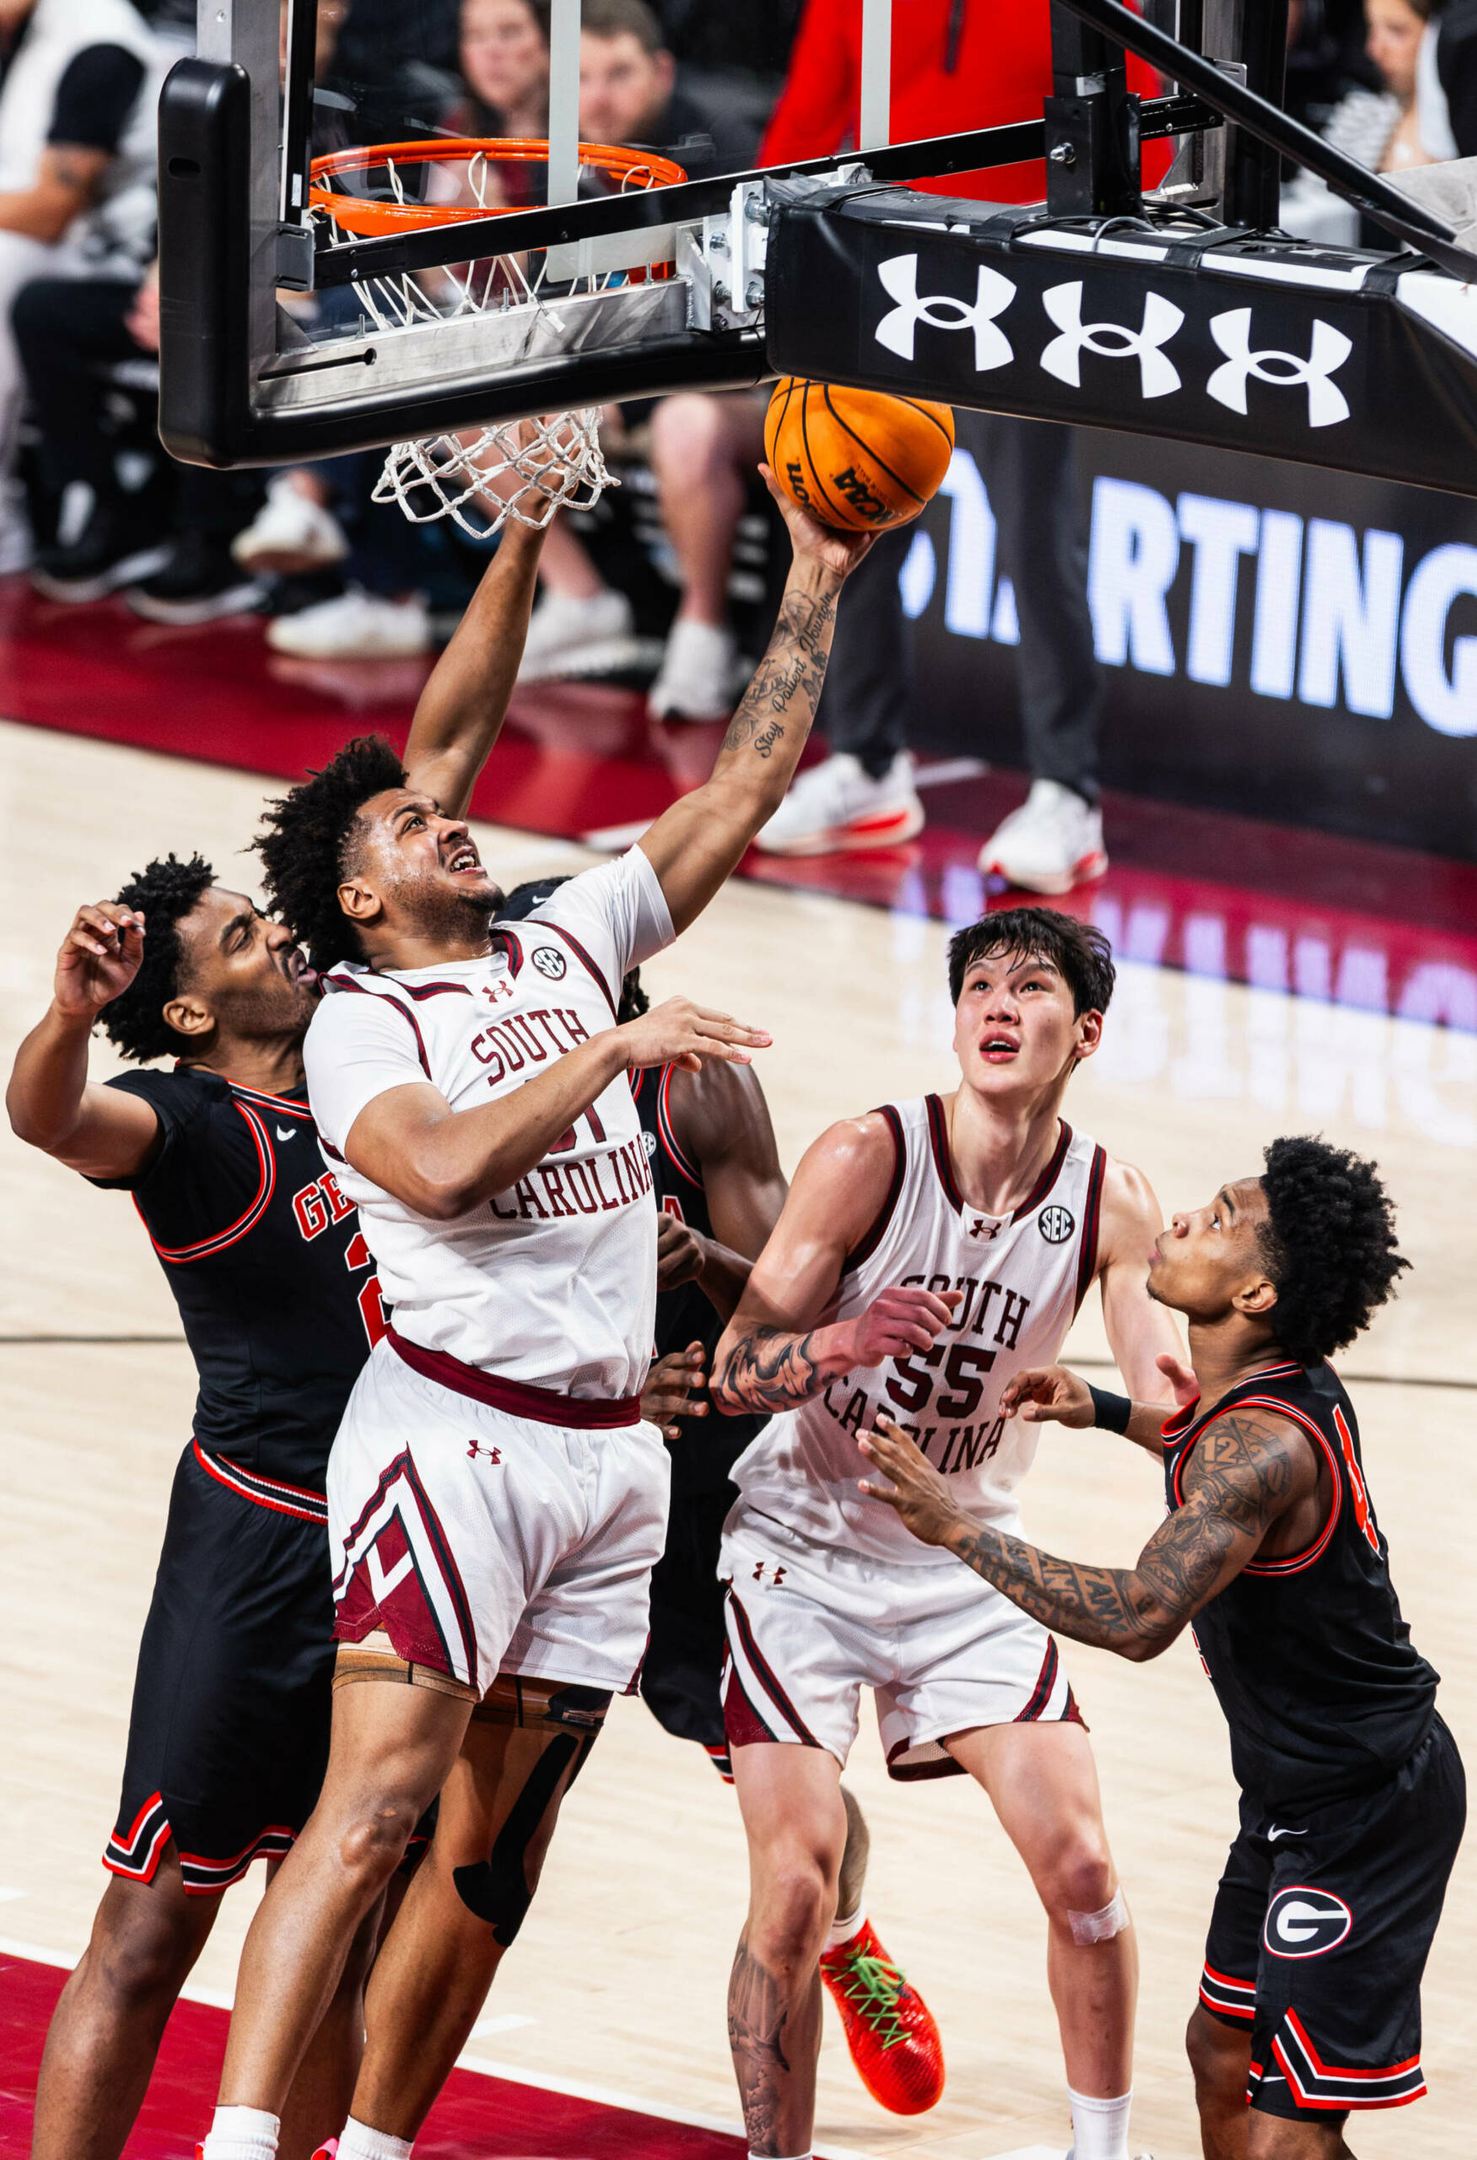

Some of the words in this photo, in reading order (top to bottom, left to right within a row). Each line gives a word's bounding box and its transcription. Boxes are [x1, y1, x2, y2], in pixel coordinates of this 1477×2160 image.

[899, 447, 1477, 738] TRTING
[754, 720, 785, 759] Stay
[771, 657, 808, 714] Patient
[533, 947, 566, 979] SEC
[470, 1008, 591, 1087] SOUTH
[1041, 1207, 1072, 1242] SEC
[901, 1274, 1031, 1351] UTH
[885, 1343, 997, 1420] 55
[1265, 1888, 1351, 1957] G
